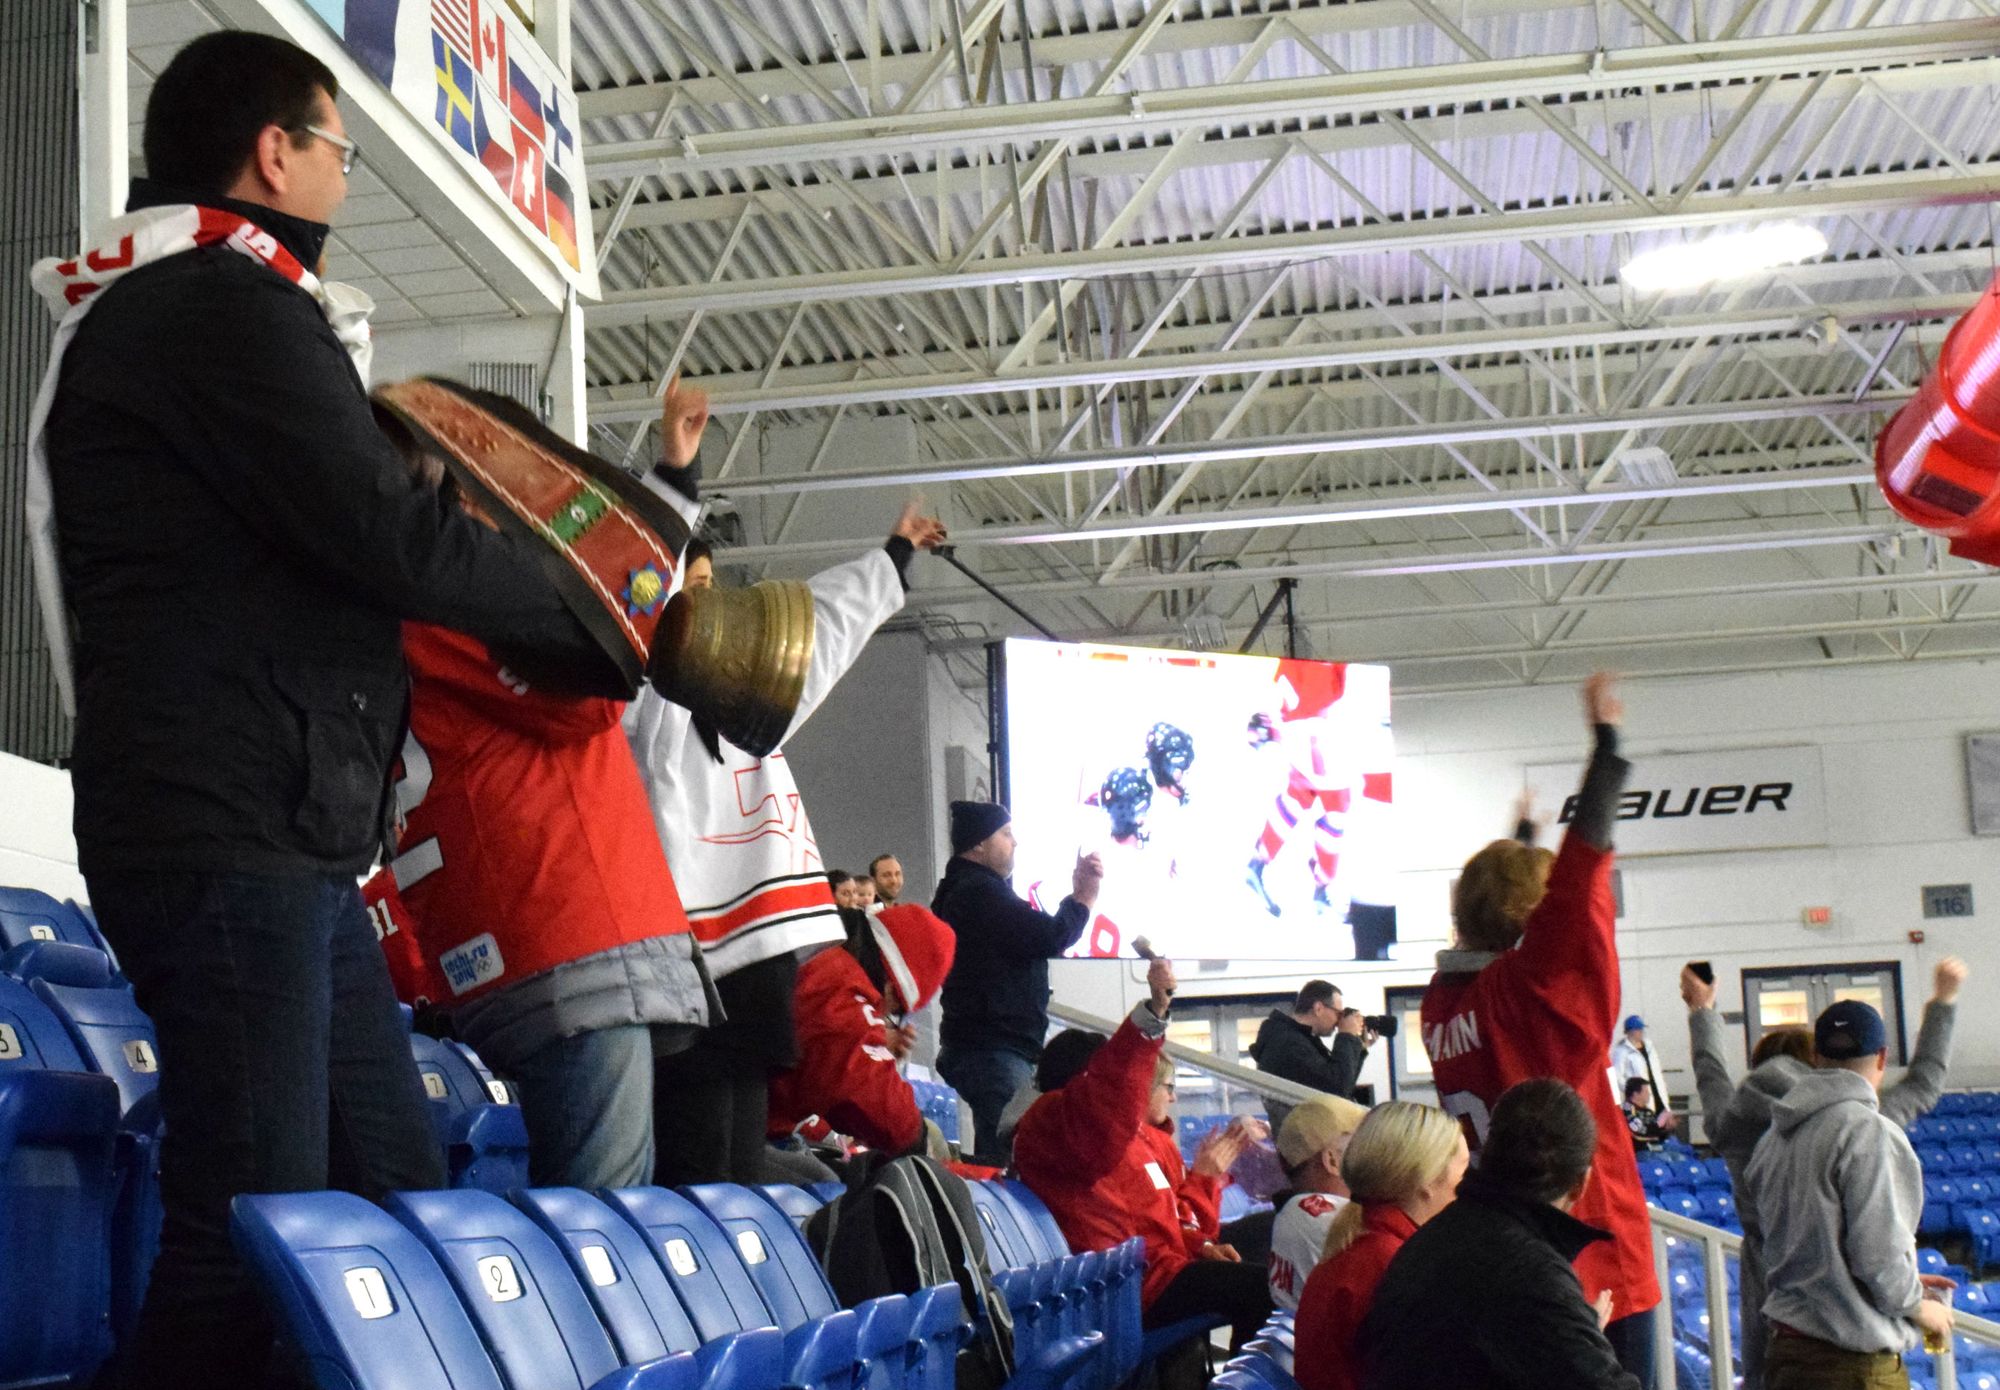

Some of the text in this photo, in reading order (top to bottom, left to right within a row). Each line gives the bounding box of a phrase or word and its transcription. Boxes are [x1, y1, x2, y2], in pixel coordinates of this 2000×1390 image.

[135, 1045, 148, 1067] 4
[494, 1084, 504, 1101] 8
[490, 1264, 508, 1294] 2
[359, 1277, 376, 1309] 1
